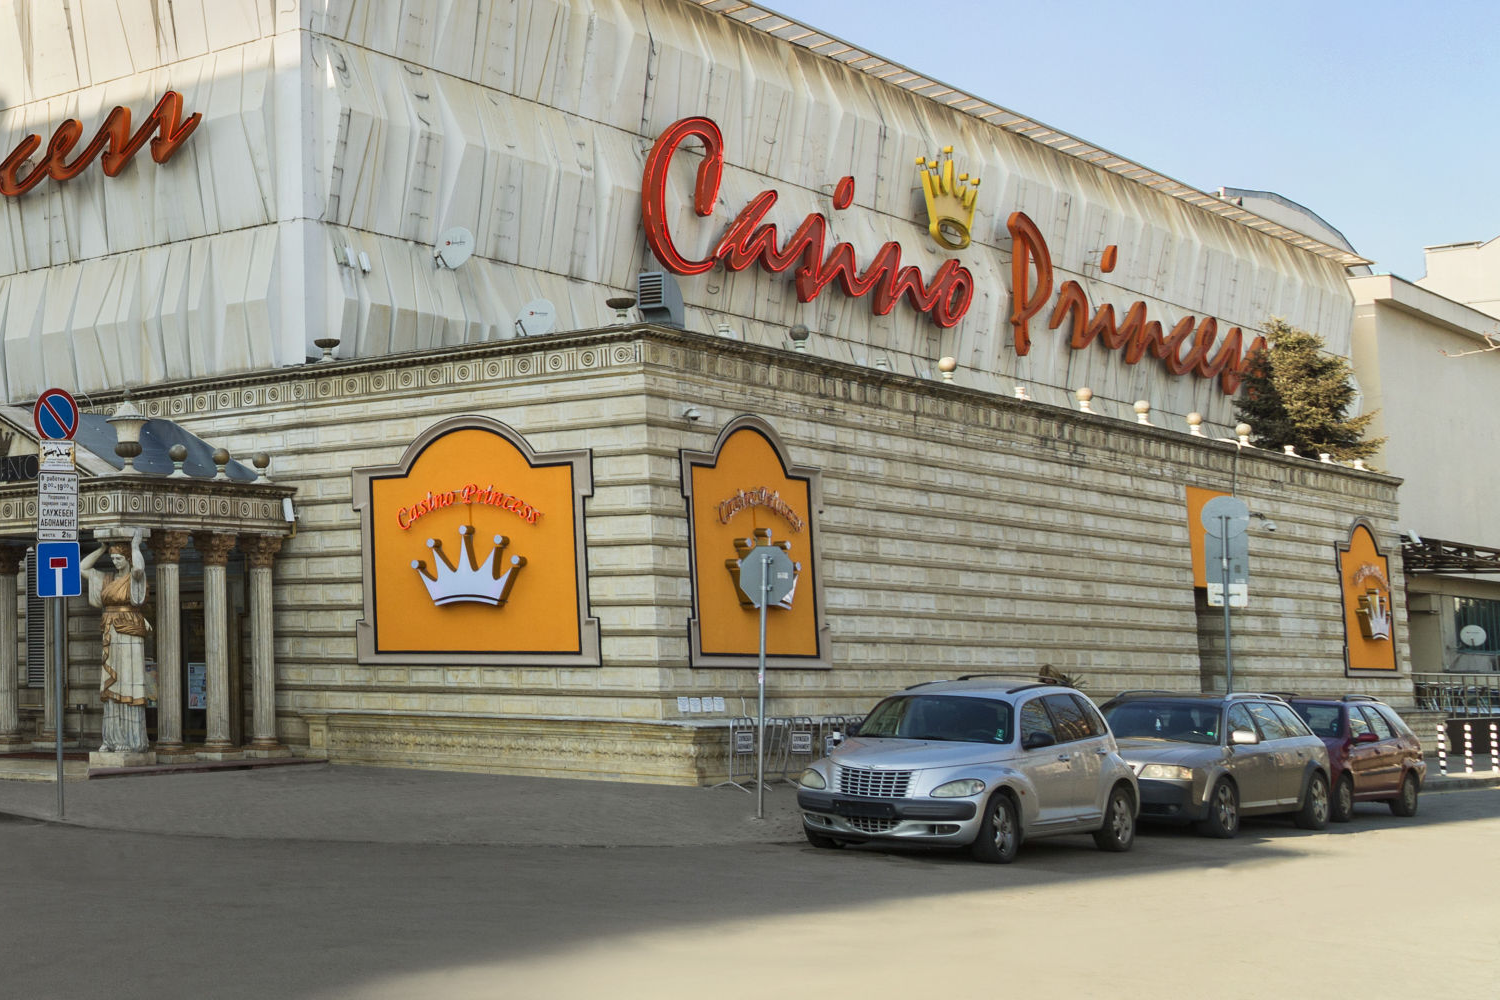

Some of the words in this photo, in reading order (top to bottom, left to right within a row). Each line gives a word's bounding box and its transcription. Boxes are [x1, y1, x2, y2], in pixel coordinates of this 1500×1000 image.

[642, 116, 974, 328] Casino
[42, 508, 73, 517] СЛУЖЕБЕН
[397, 491, 456, 530] Casino
[461, 483, 540, 524] Princess
[40, 518, 75, 527] АБОНАМЕНТ
